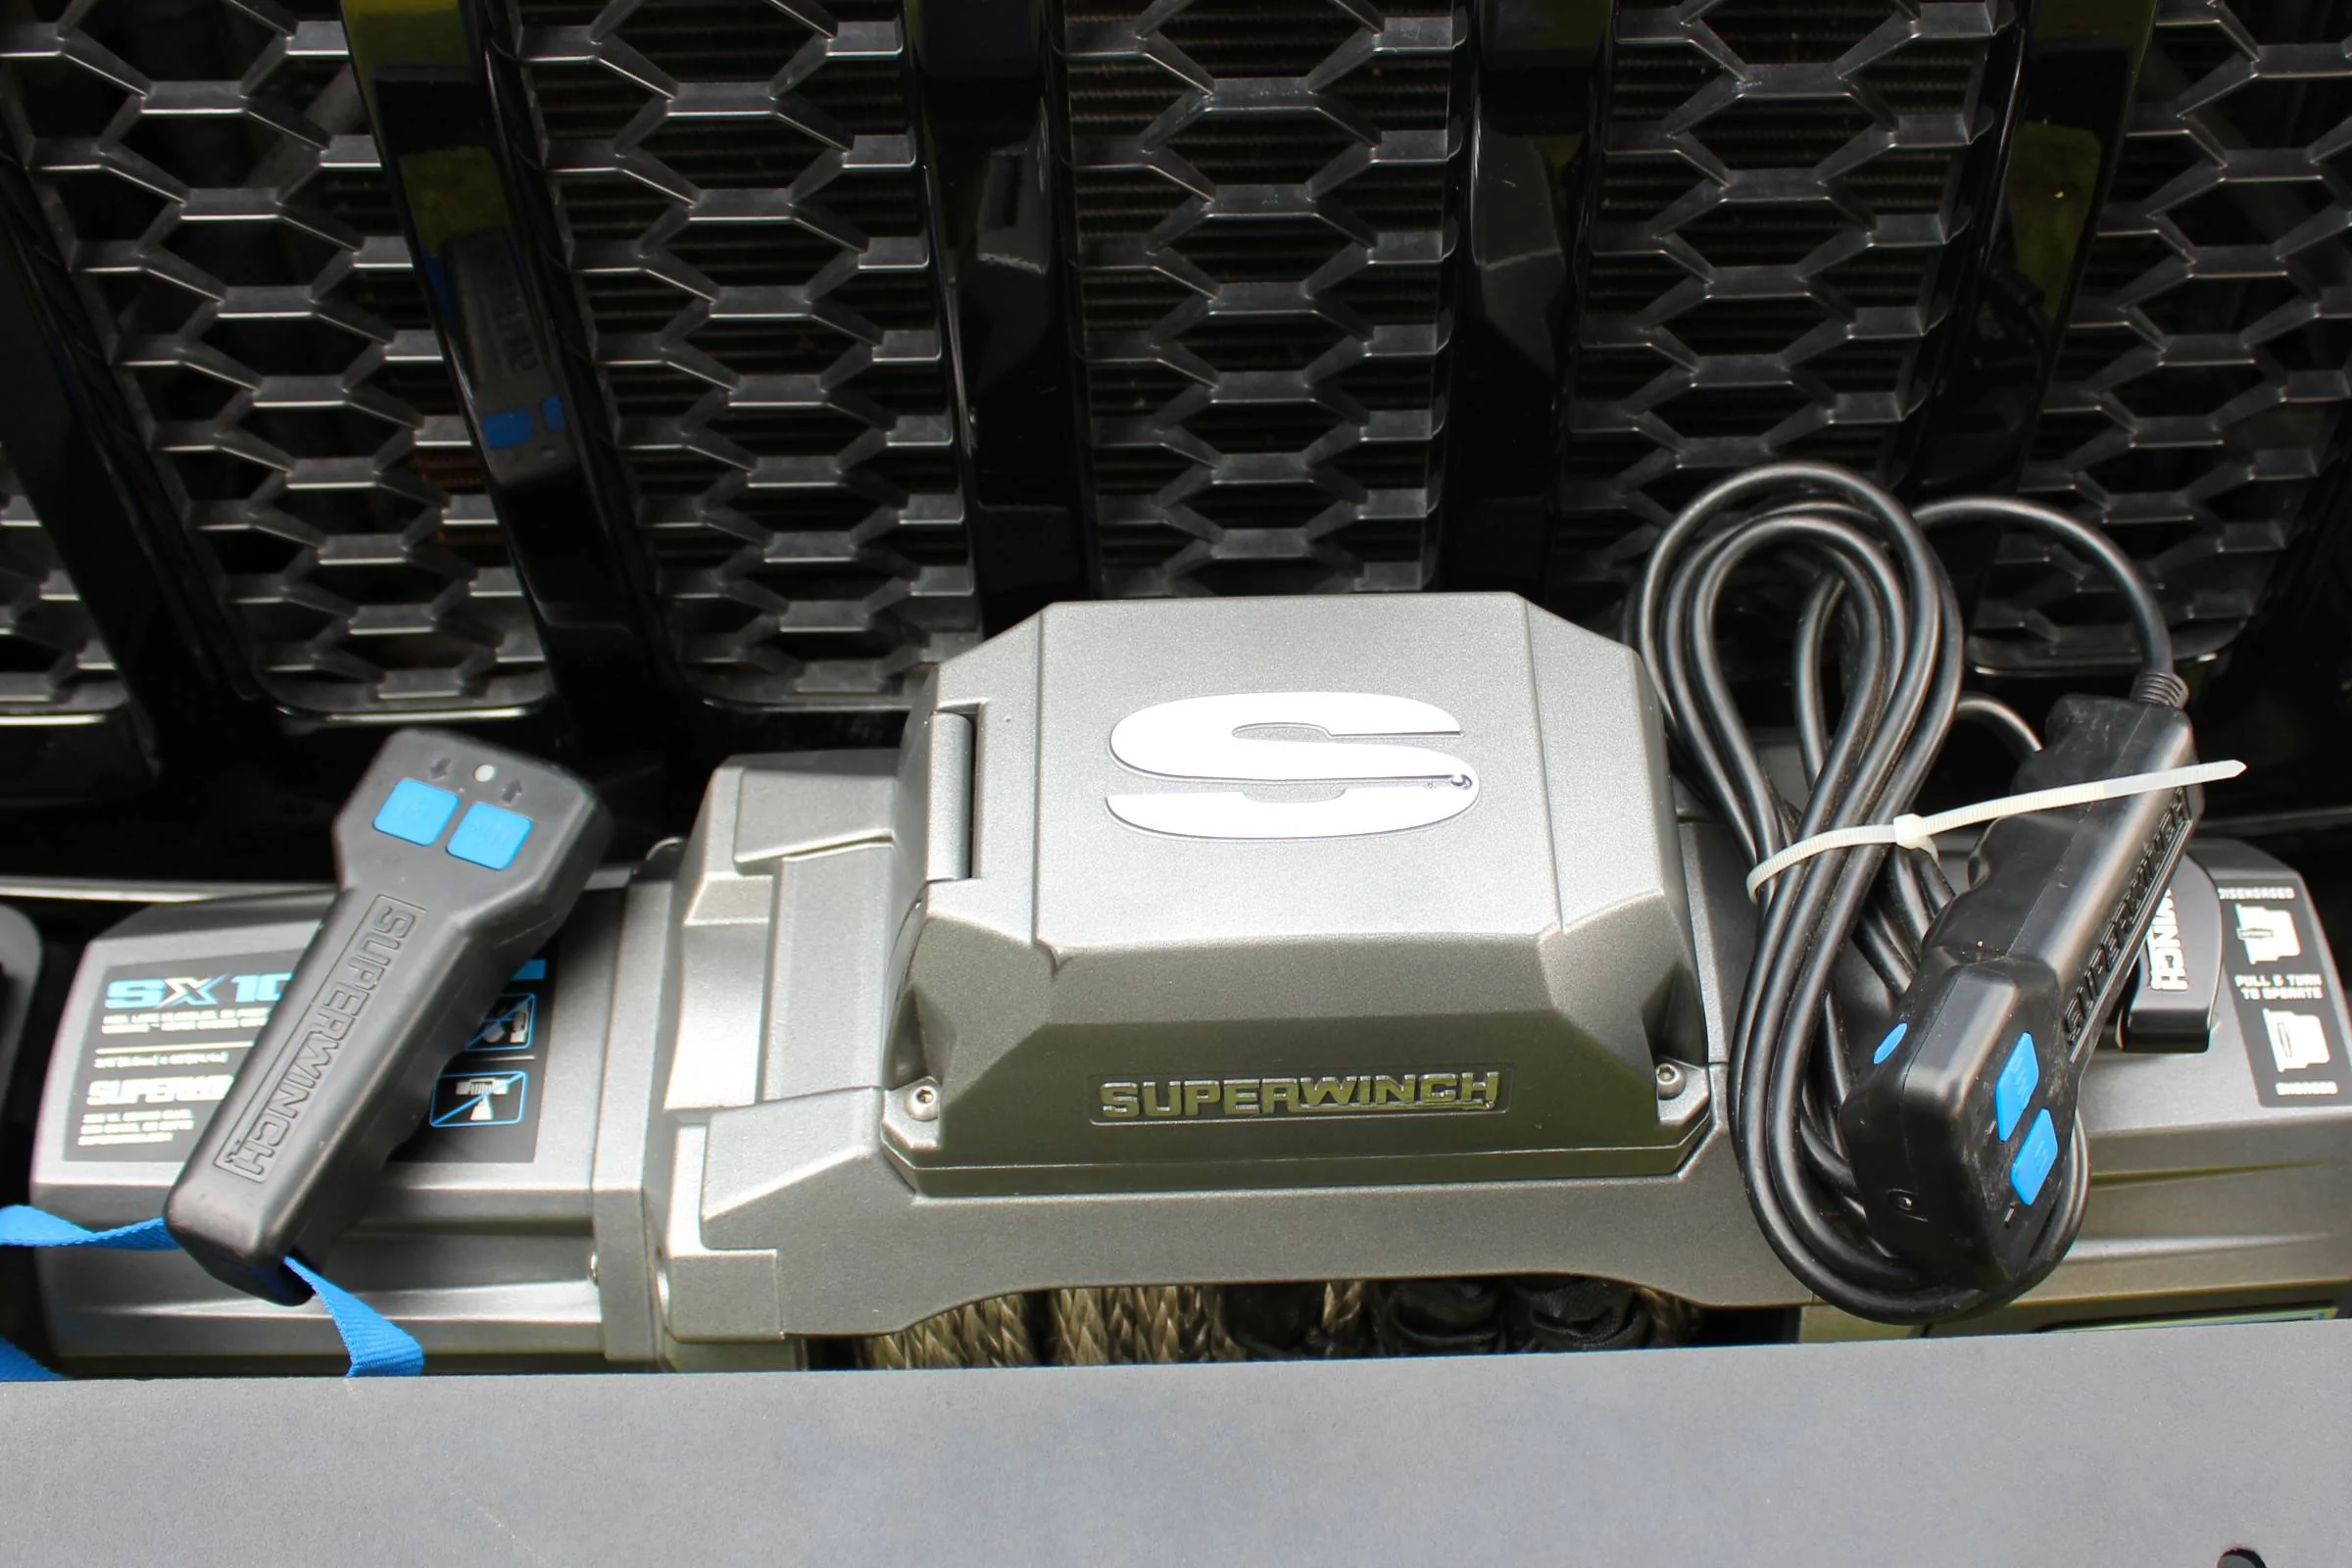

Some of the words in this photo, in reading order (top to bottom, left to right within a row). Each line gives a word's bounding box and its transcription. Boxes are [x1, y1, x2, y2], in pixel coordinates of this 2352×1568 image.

[2235, 974, 2271, 988] PULL
[2274, 973, 2283, 988] &
[2287, 973, 2322, 988] TURN
[2241, 987, 2260, 1001] TO
[2263, 987, 2323, 1001] OPERATE
[223, 905, 416, 1176] SUPERWINCH
[1099, 1071, 1500, 1118] SUPERWINCH
